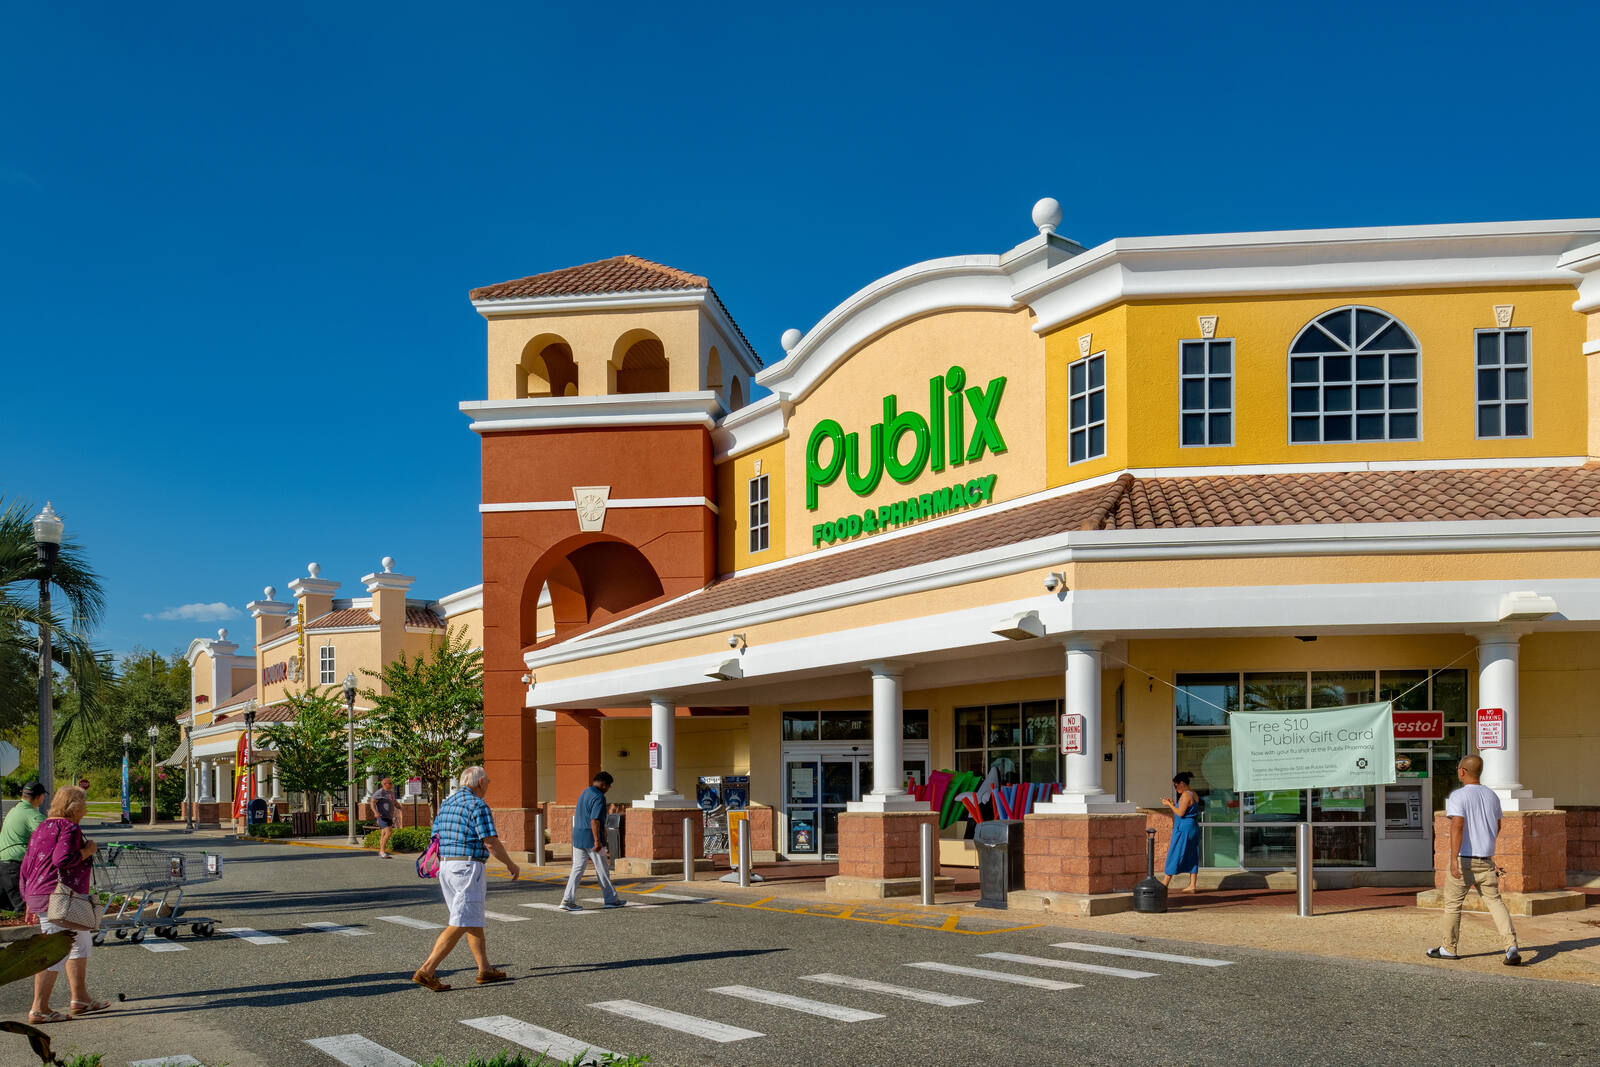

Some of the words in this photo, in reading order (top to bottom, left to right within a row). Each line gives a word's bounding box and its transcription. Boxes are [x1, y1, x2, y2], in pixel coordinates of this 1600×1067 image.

[812, 514, 863, 546] FOOD
[878, 473, 998, 528] PHARMACY
[1026, 716, 1056, 729] 2424
[1067, 717, 1076, 725] NO
[1249, 720, 1280, 733] Free
[1283, 718, 1309, 732] $10
[1063, 725, 1080, 733] PARKING
[1263, 733, 1306, 746] Publix
[1309, 730, 1332, 743] Gift
[1337, 728, 1374, 742] Card
